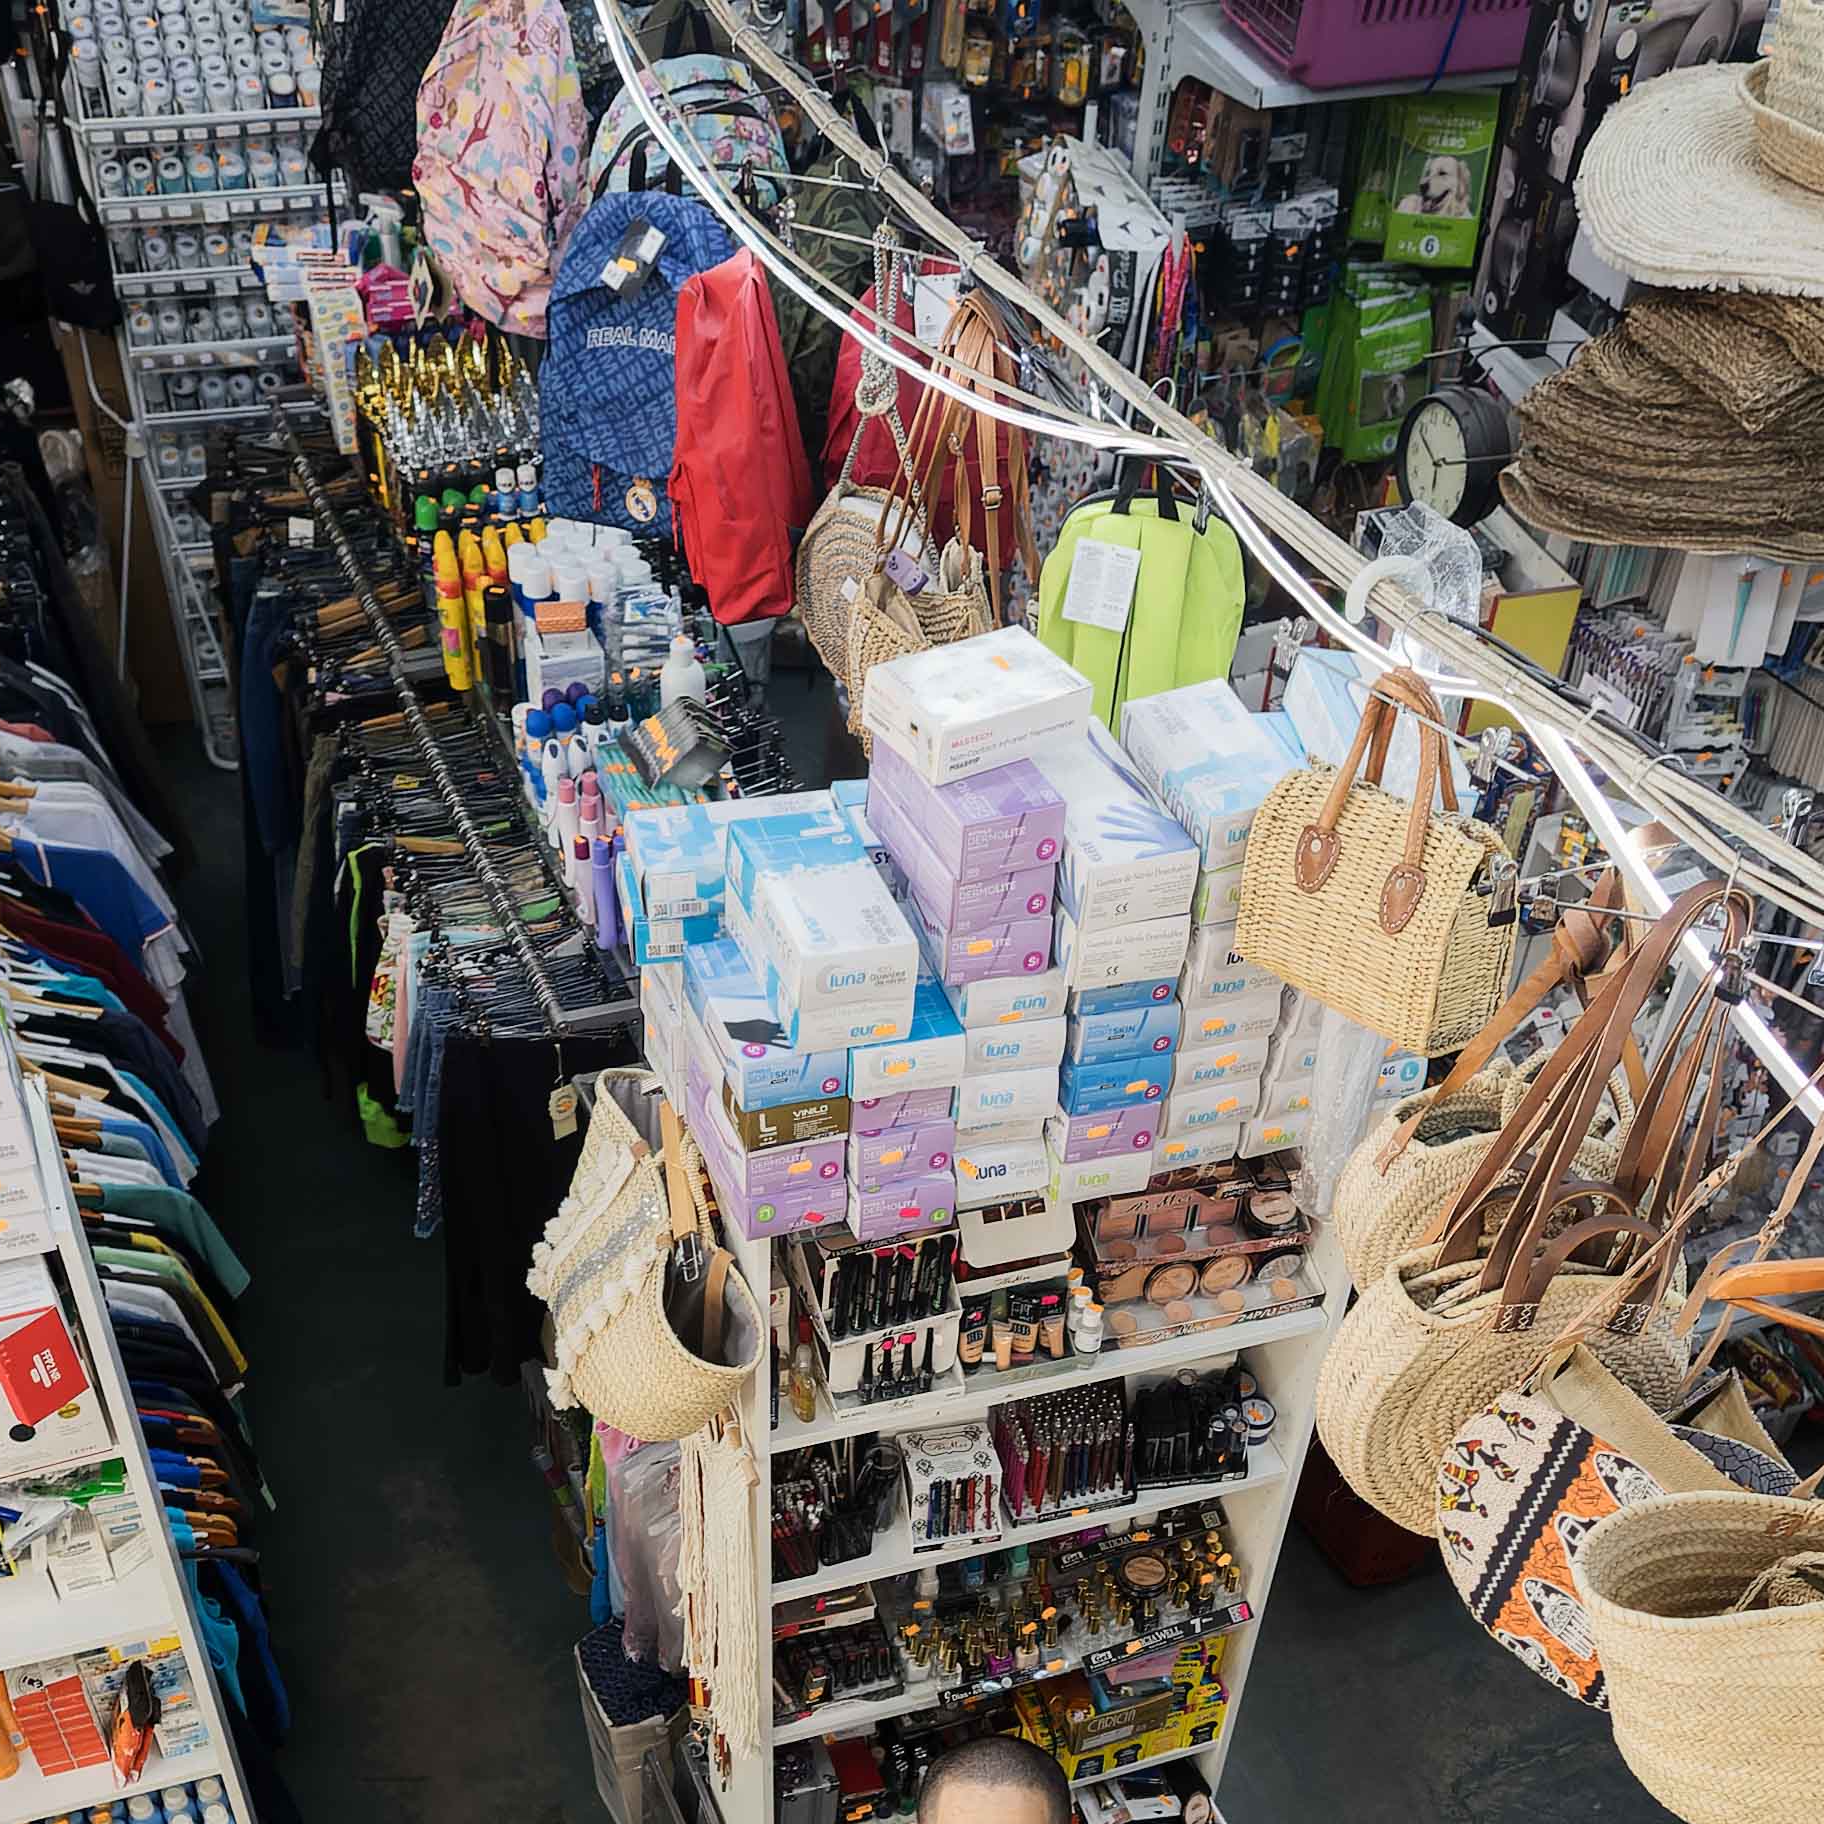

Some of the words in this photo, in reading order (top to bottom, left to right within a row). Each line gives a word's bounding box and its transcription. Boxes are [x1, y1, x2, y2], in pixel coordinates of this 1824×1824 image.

[587, 326, 636, 348] REAL
[966, 827, 1026, 844] DERMOLITE
[958, 881, 1017, 898] DERMOLITE
[829, 970, 866, 989] luna
[1211, 976, 1247, 994] luna
[985, 1042, 1021, 1058] luna
[1194, 1066, 1225, 1080] luna
[978, 1091, 1014, 1108] luna
[792, 1104, 829, 1118] VINILO
[1187, 1109, 1219, 1125] luna
[1078, 1172, 1111, 1187] luna
[863, 1237, 905, 1250] COSMETICS
